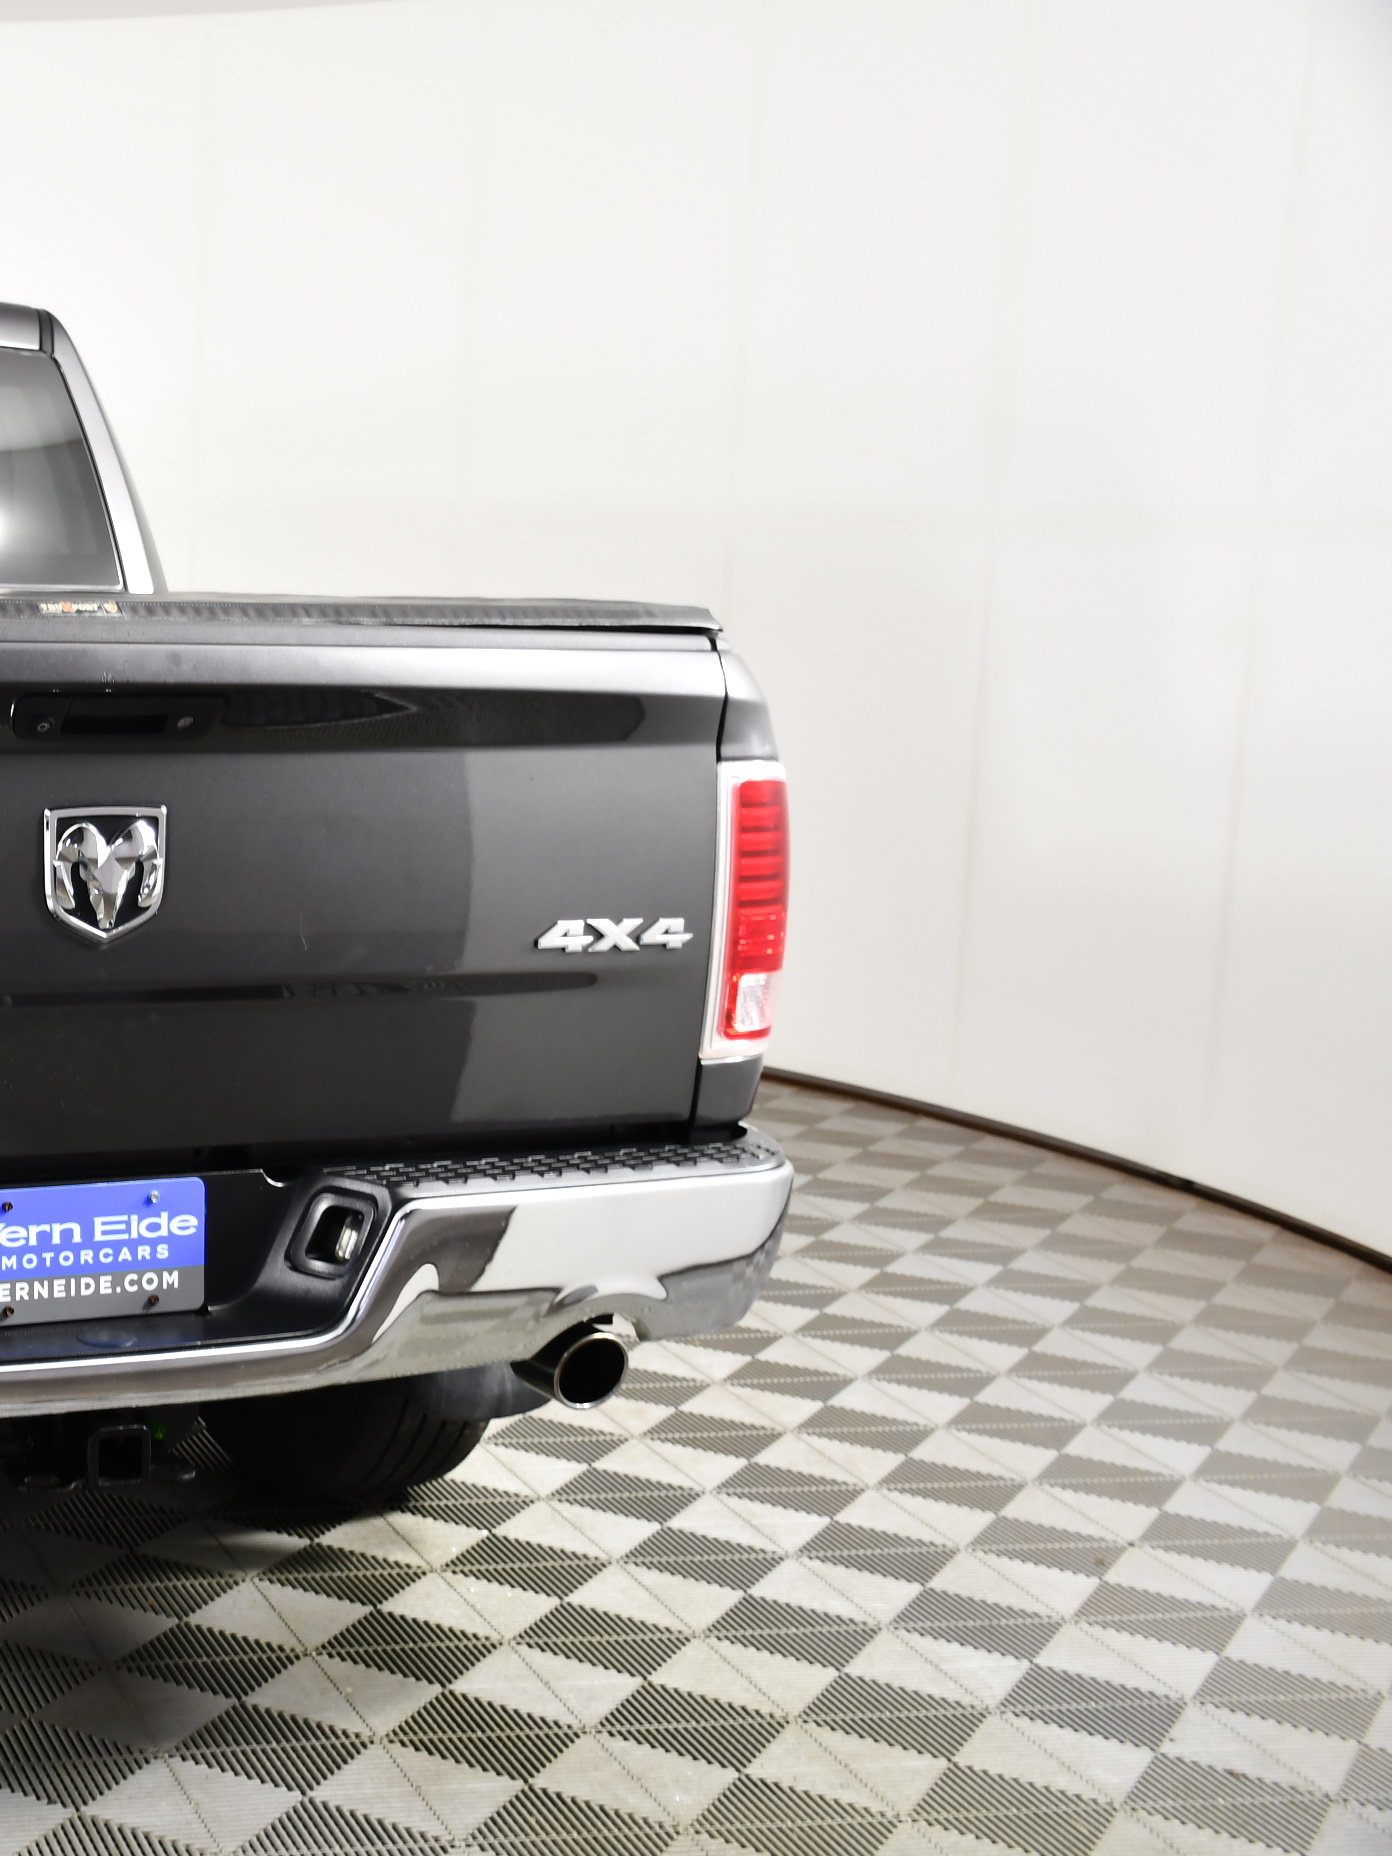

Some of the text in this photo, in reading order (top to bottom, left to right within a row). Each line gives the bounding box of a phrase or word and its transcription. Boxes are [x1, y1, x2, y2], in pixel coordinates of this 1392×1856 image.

[533, 917, 694, 953] 4X4
[93, 1211, 199, 1242] Eide
[1, 1244, 170, 1271] MOTORCARS
